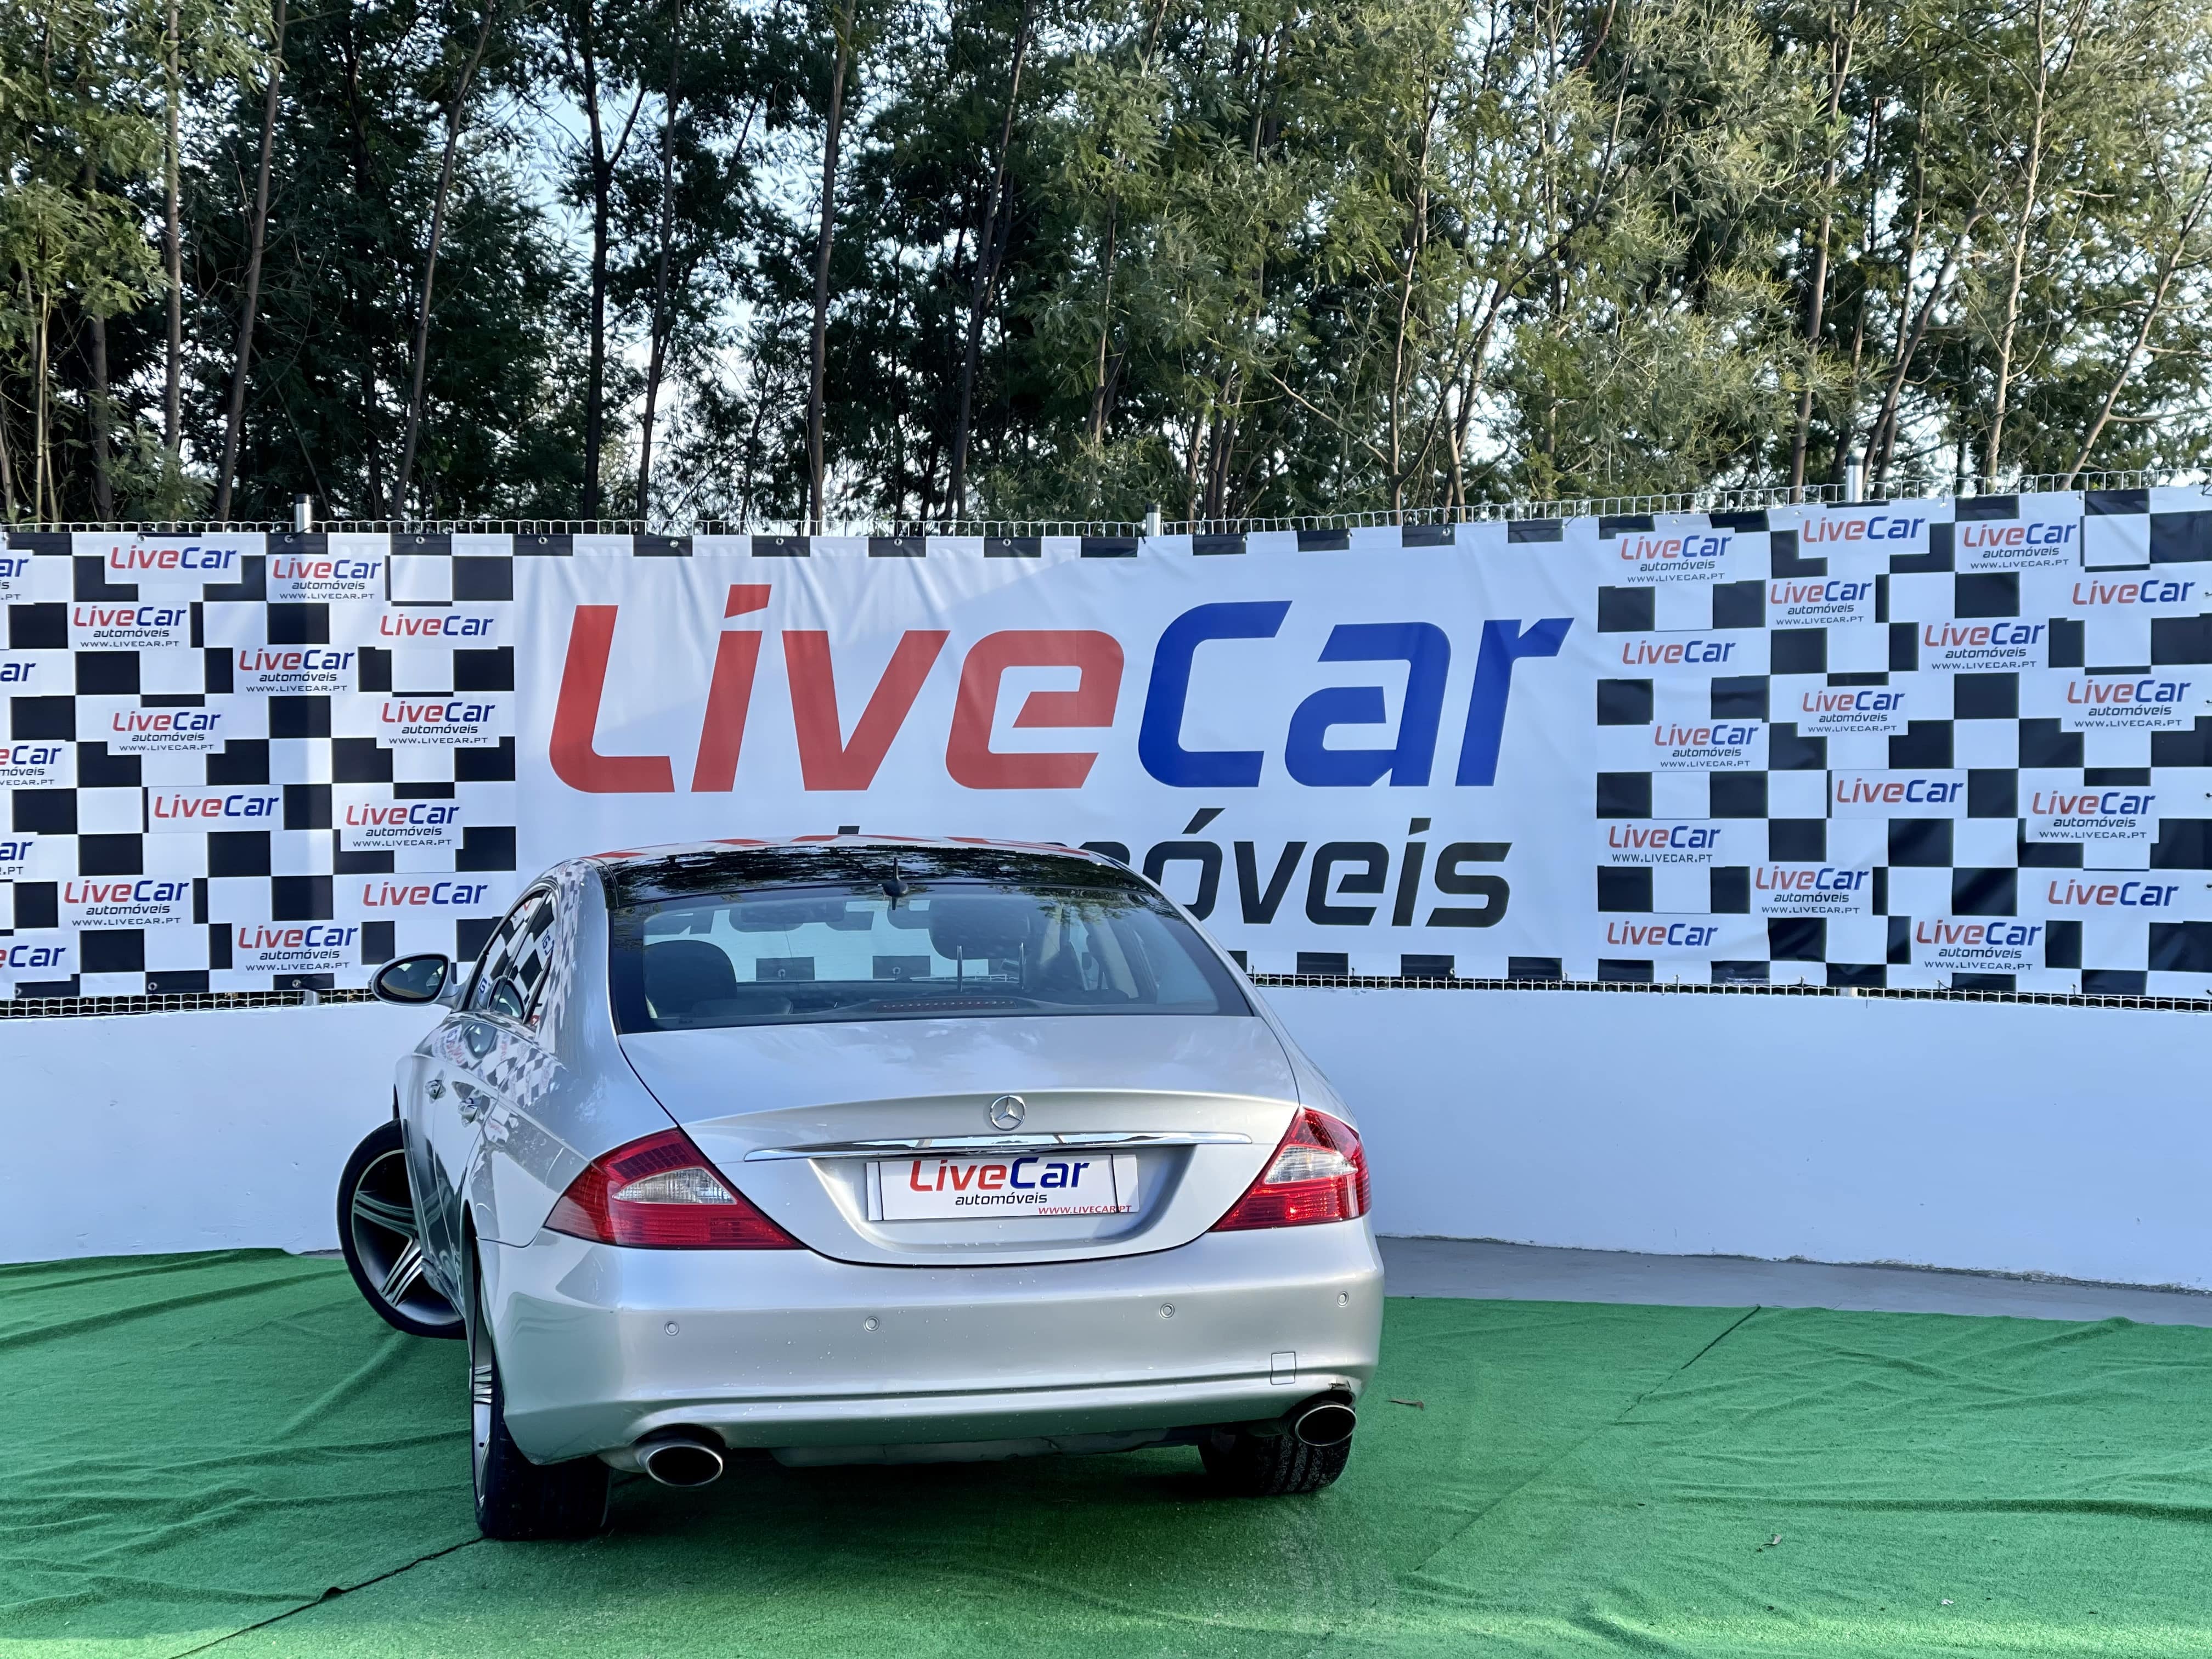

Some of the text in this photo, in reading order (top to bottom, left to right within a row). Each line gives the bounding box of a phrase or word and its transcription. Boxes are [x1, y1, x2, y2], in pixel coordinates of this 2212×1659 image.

[1804, 516, 1925, 542] LiveCar
[1964, 523, 2076, 547] LiveCar
[111, 545, 237, 568] LiveCar
[1621, 535, 1732, 560] LiveCar
[1983, 546, 2059, 558] automóveis
[273, 557, 382, 580] LiveCar
[1640, 559, 1715, 571] automóveis
[1971, 559, 2068, 568] WWW.LIVECAR.PT
[291, 580, 365, 591] automóveis
[1628, 573, 1724, 582] WWW.LIVECAR.PT
[1771, 581, 1872, 604] LiveCar
[2073, 580, 2195, 605] LiveCar
[74, 606, 187, 627] LiveCar
[1788, 603, 1854, 614] automóveis
[381, 614, 494, 636] LiveCar
[1776, 616, 1863, 624] WWW.LIVECAR.PT
[93, 628, 170, 637] automóveis
[1925, 623, 2045, 646] LiveCar
[239, 648, 355, 670] LiveCar
[1623, 641, 1736, 664] LiveCar
[1945, 647, 2026, 658] automóveis
[1932, 661, 2036, 669] WWW.LIVECAR.PT
[259, 672, 337, 682] automóveis
[549, 584, 1575, 793] LiveCar
[2067, 680, 2191, 703] LiveCar
[382, 701, 495, 723] LiveCar
[1803, 691, 1905, 712] LiveCar
[2089, 704, 2171, 716] automóveis
[113, 711, 221, 731] LiveCar
[402, 724, 478, 733] automóveis
[1819, 713, 1887, 723] automóveis
[132, 732, 204, 741] automóveis
[1655, 724, 1759, 746] LiveCar
[1673, 747, 1741, 757] automóveis
[0, 766, 44, 776] móveis
[1837, 778, 1963, 803] LiveCar
[155, 794, 279, 817] LiveCar
[2033, 791, 2155, 814] LiveCar
[346, 803, 461, 825] LiveCar
[2053, 816, 2136, 827] automóveis
[366, 826, 442, 836] automóveis
[1609, 825, 1721, 848] LiveCar
[1042, 808, 1513, 929] óveis
[1612, 854, 1712, 862] WWW.LIVECAR.PT
[1756, 866, 1869, 890] LiveCar
[64, 880, 189, 904] LiveCar
[363, 882, 488, 906] LiveCar
[1774, 891, 1849, 902] automóveis
[2049, 881, 2179, 906] LiveCar
[86, 904, 170, 915] automóveis
[72, 917, 180, 926] WWW.LIVECAR.PT
[1916, 919, 2042, 945] LiveCar
[239, 926, 358, 949] LiveCar
[1607, 921, 1718, 946] LiveCar
[259, 949, 340, 960] automóveis
[1939, 947, 2022, 958] automóveis
[246, 962, 349, 970] WWW.LIVECAR.PT
[1925, 961, 2033, 970] WWW.LIVECAR.PT
[909, 1157, 1090, 1192] LiveCar
[955, 1192, 1047, 1205] automóveis
[1038, 1205, 1132, 1215] WWW.LIVECARPT
